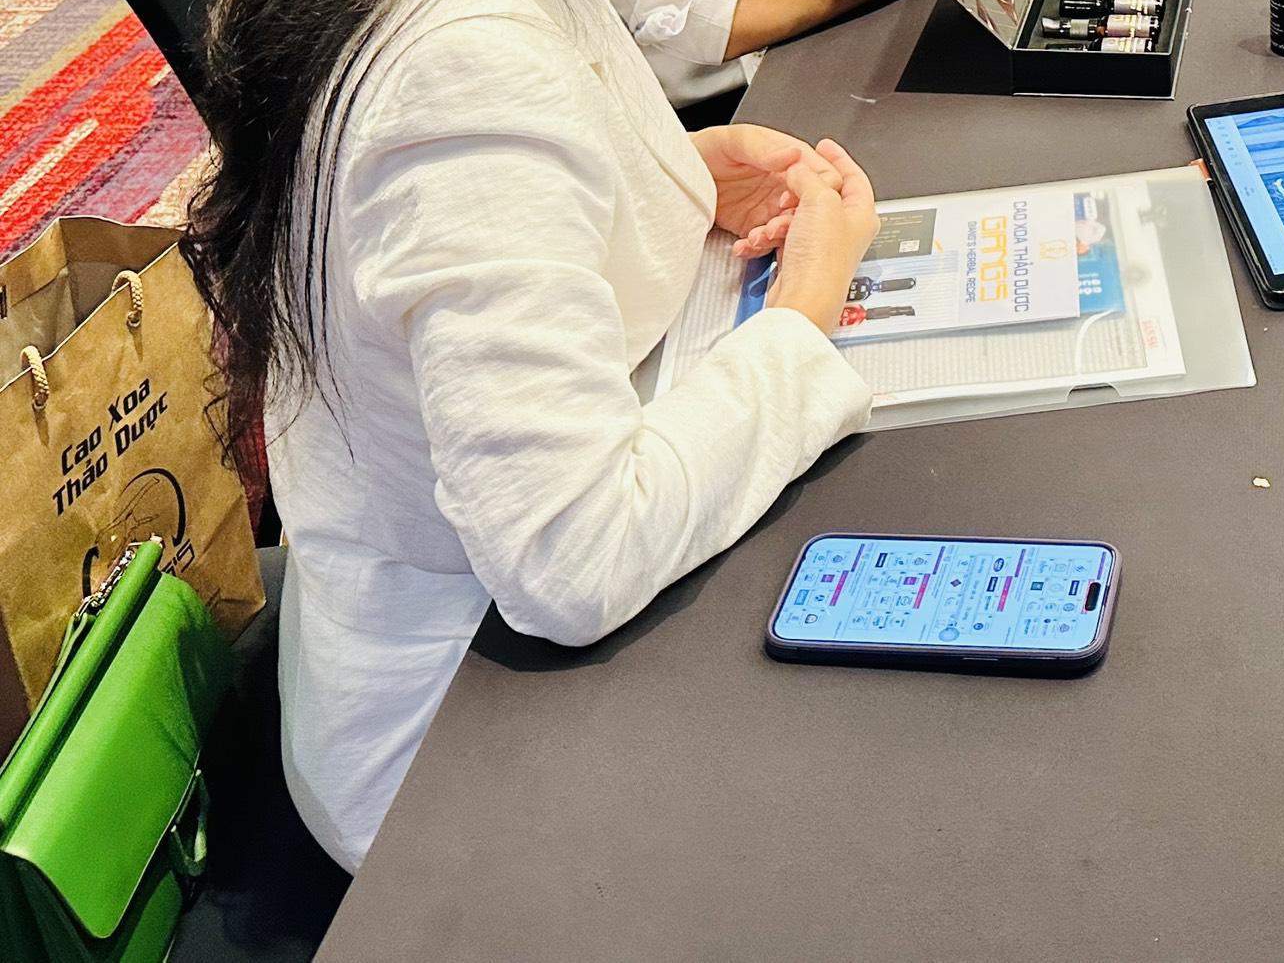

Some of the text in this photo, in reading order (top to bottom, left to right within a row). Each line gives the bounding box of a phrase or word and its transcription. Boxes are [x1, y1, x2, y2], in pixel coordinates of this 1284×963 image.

[965, 278, 976, 304] RECIPE
[966, 248, 976, 277] HERBAL
[1013, 200, 1034, 312] CAO XOA THẢO DƯỢC
[52, 391, 168, 517] Thảo Dược
[61, 378, 151, 477] Cao Xoa
